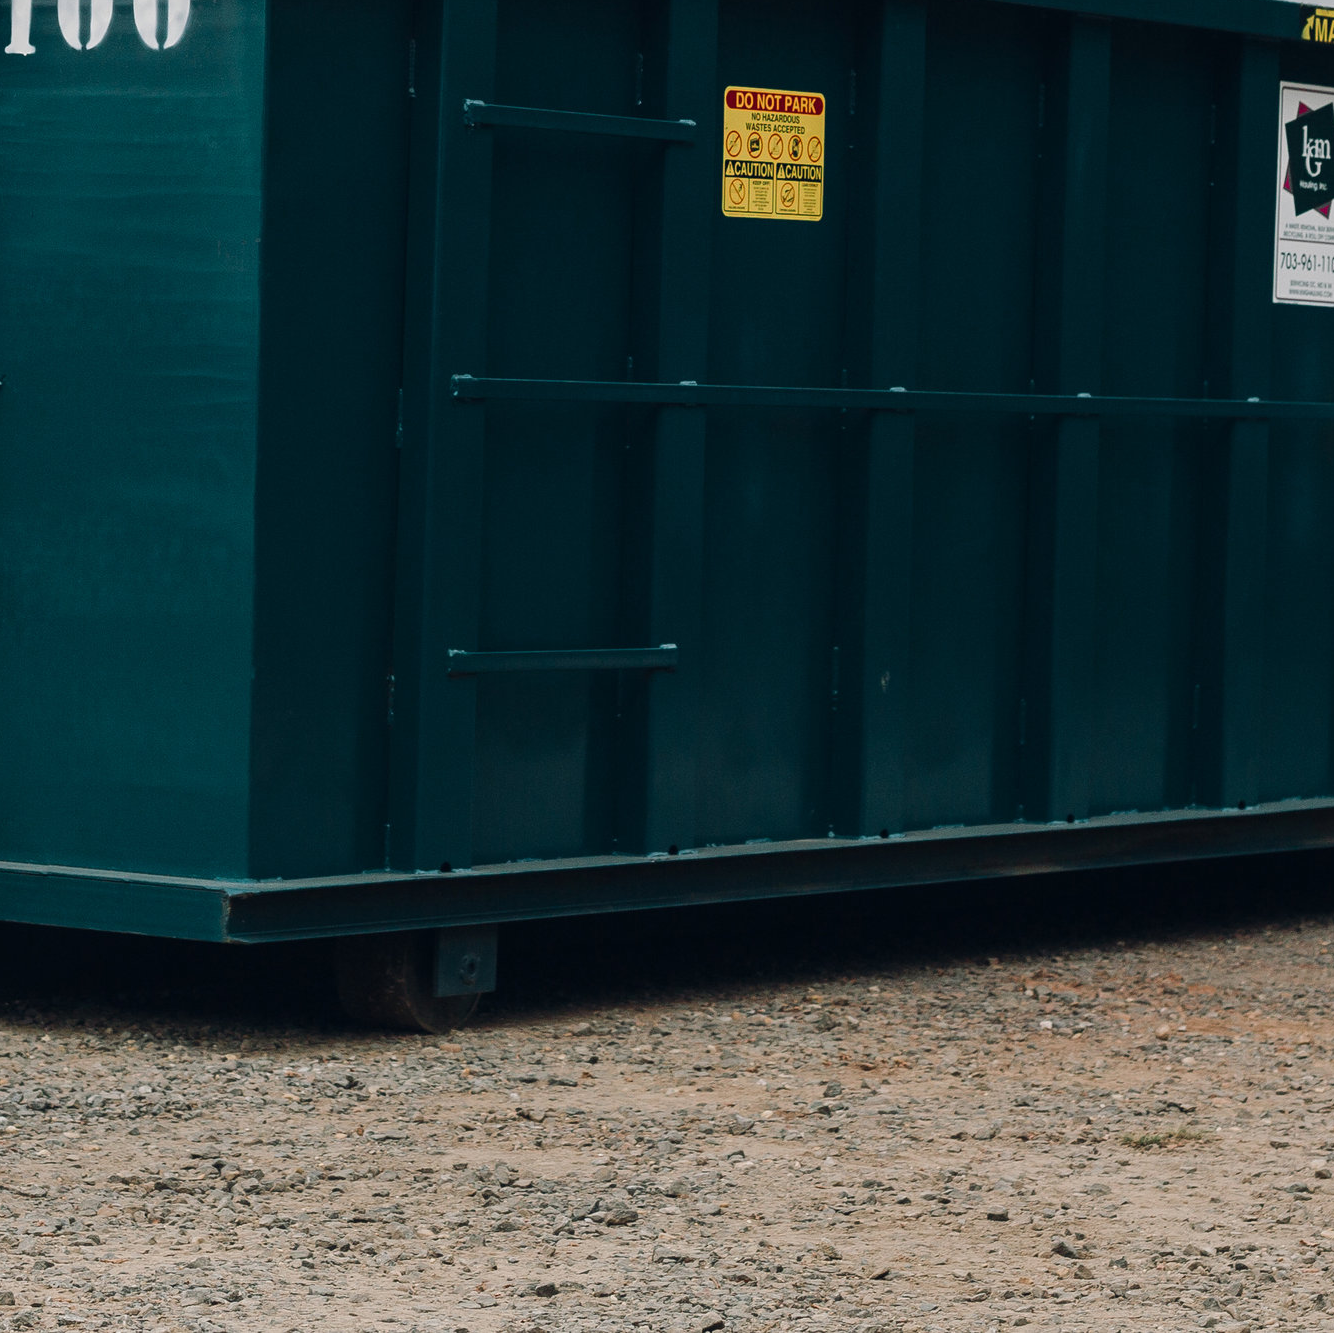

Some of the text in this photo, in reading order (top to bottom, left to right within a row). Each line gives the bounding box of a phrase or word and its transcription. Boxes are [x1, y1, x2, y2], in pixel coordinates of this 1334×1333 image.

[736, 92, 817, 114] DO NOT PARK
[751, 113, 800, 124] NO HAZARDOUS
[746, 123, 806, 135] WASTES ACCEPTED
[734, 161, 773, 177] CAUTION
[785, 164, 822, 180] CAUTION
